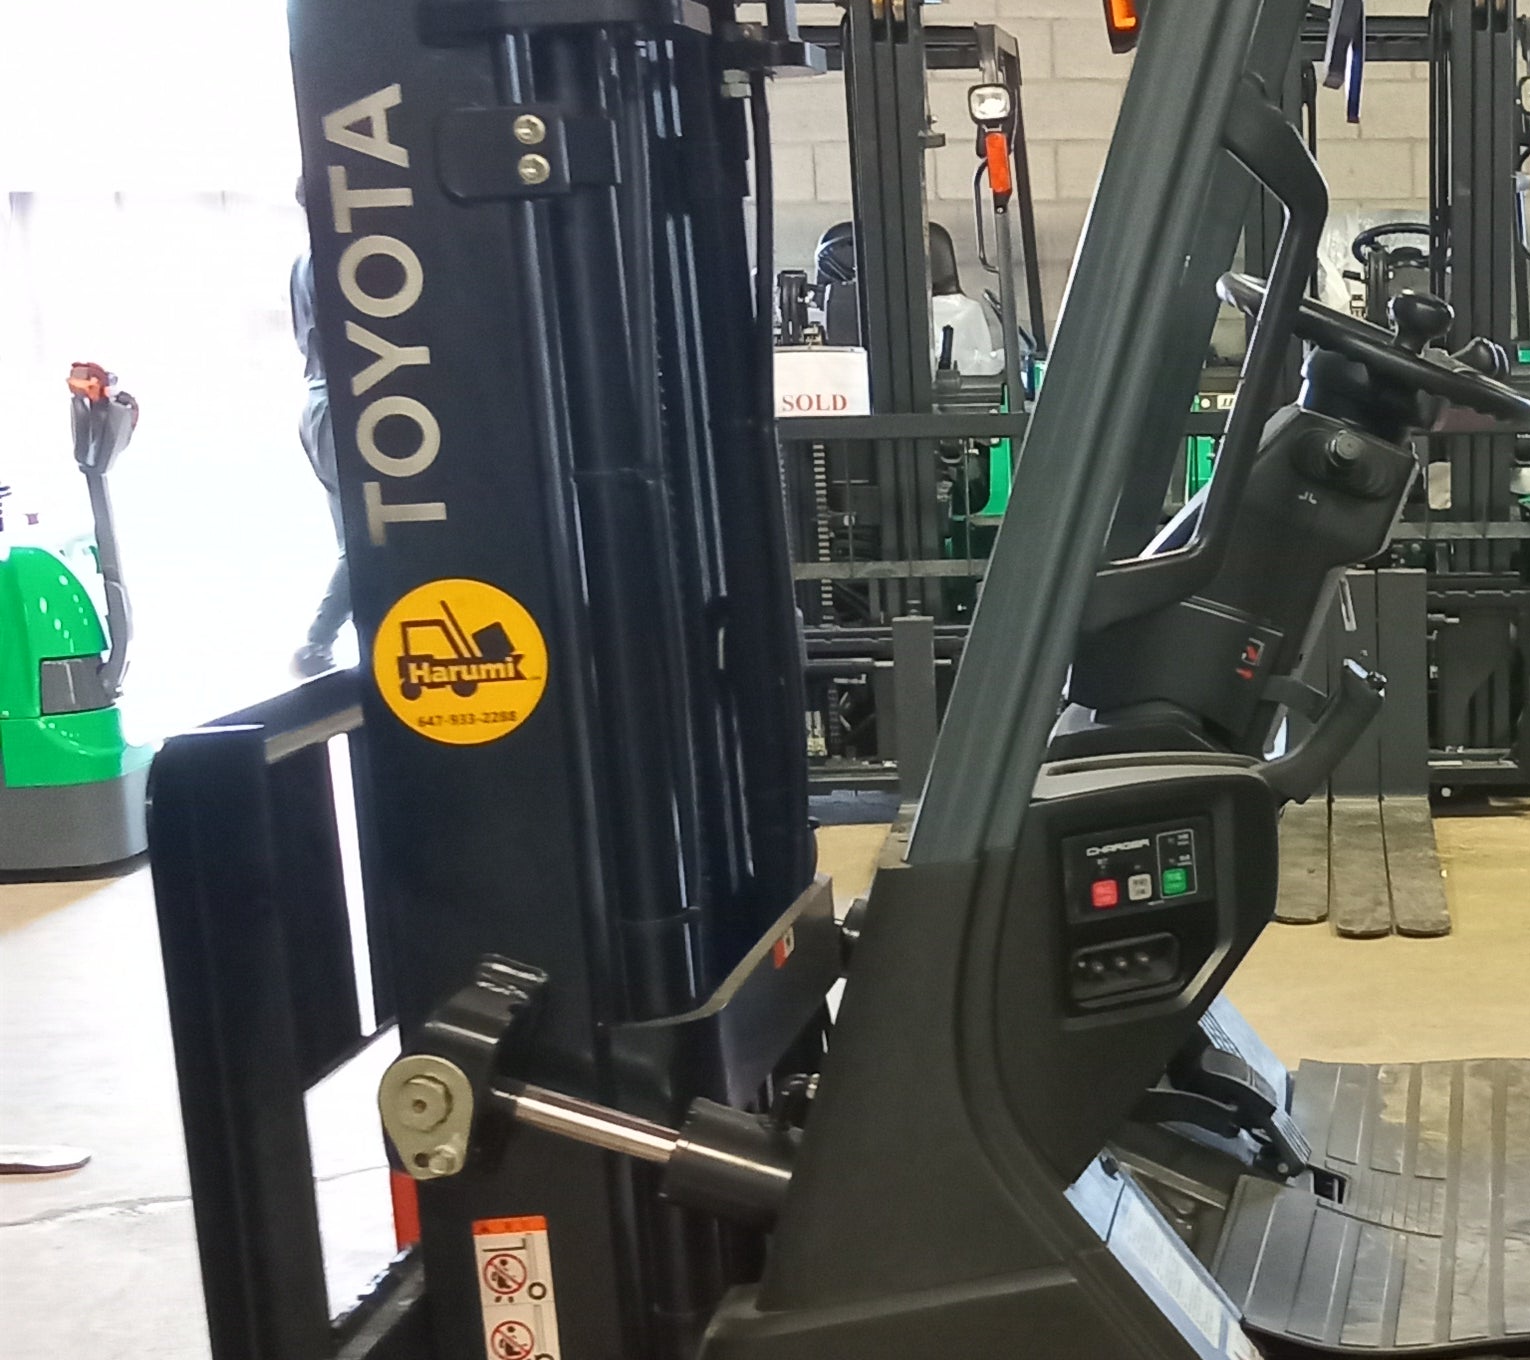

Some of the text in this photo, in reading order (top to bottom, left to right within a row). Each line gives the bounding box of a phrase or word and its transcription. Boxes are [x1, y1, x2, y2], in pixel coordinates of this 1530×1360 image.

[321, 82, 447, 547] TOYOTA
[782, 394, 848, 412] SOLD
[408, 656, 516, 684] Harumi
